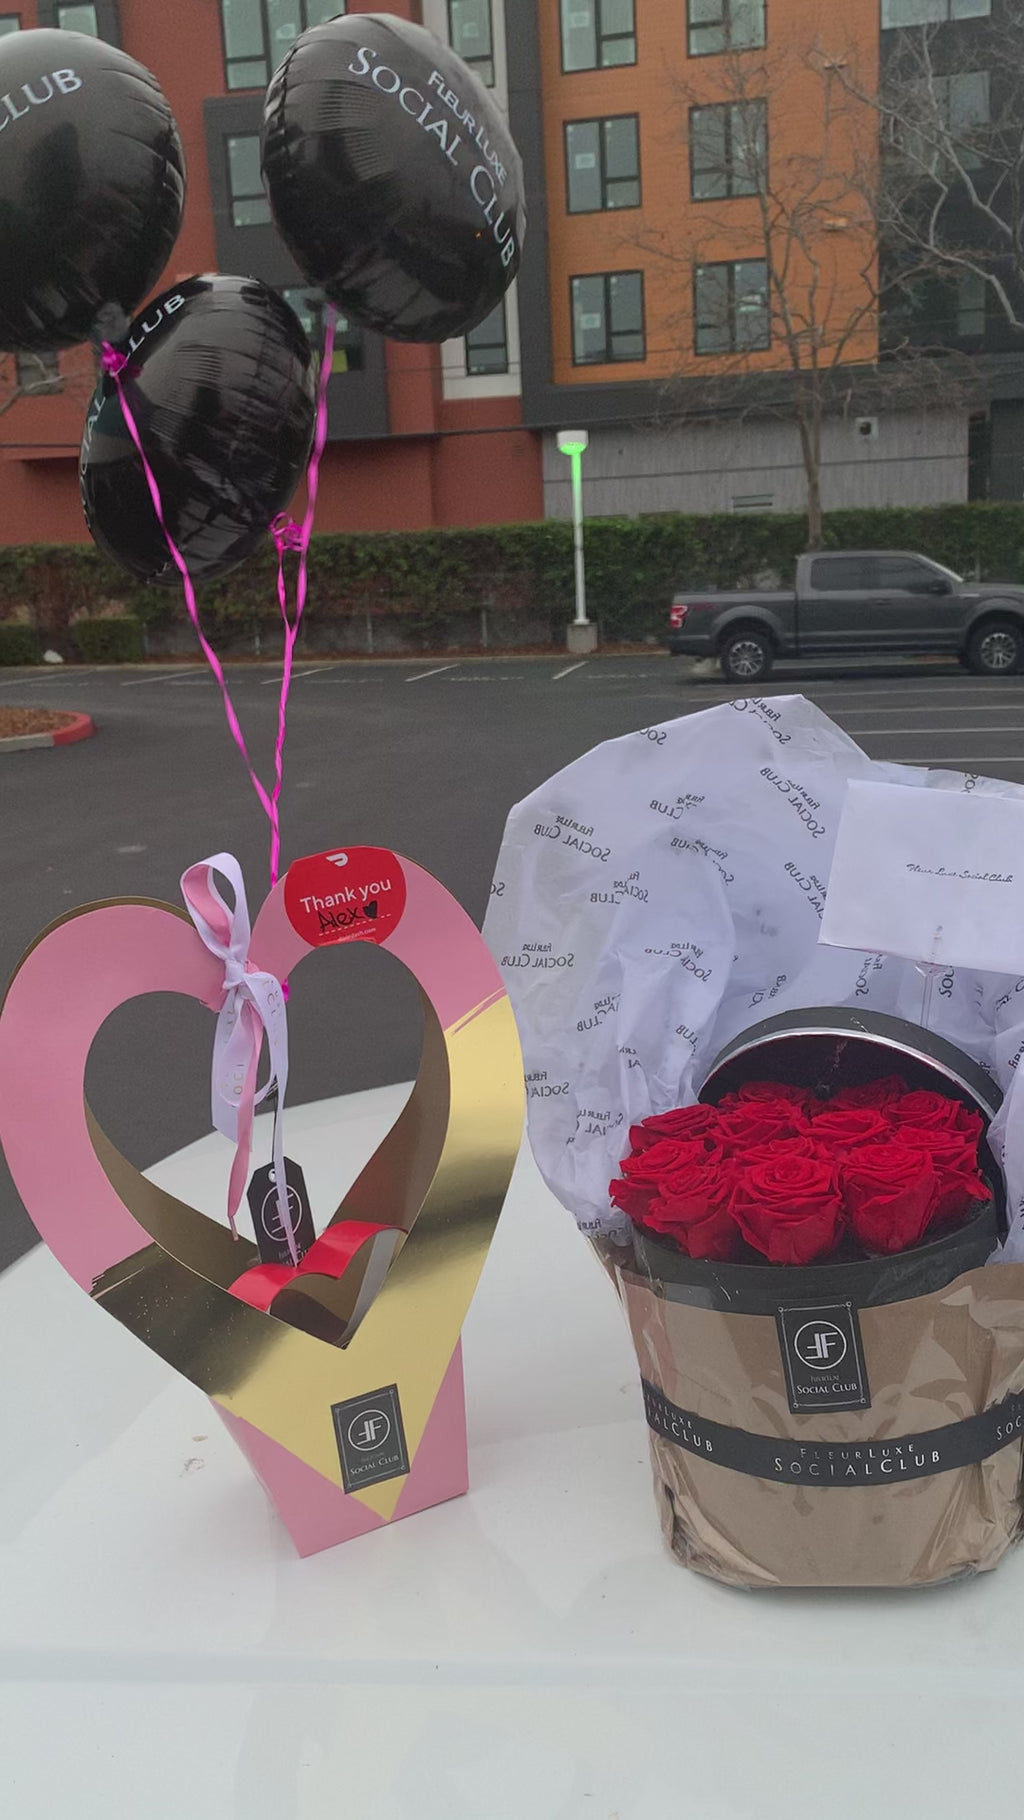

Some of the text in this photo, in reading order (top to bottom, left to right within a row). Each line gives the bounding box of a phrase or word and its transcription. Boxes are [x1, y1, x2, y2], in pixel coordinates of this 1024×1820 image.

[0, 68, 83, 131] LUB
[348, 46, 515, 267] SOCIAL CLUB
[299, 879, 392, 913] Thank you
[317, 906, 363, 932] Alex
[796, 1383, 858, 1395] SOCIAL CLUB
[350, 1461, 376, 1475] SOCIAL
